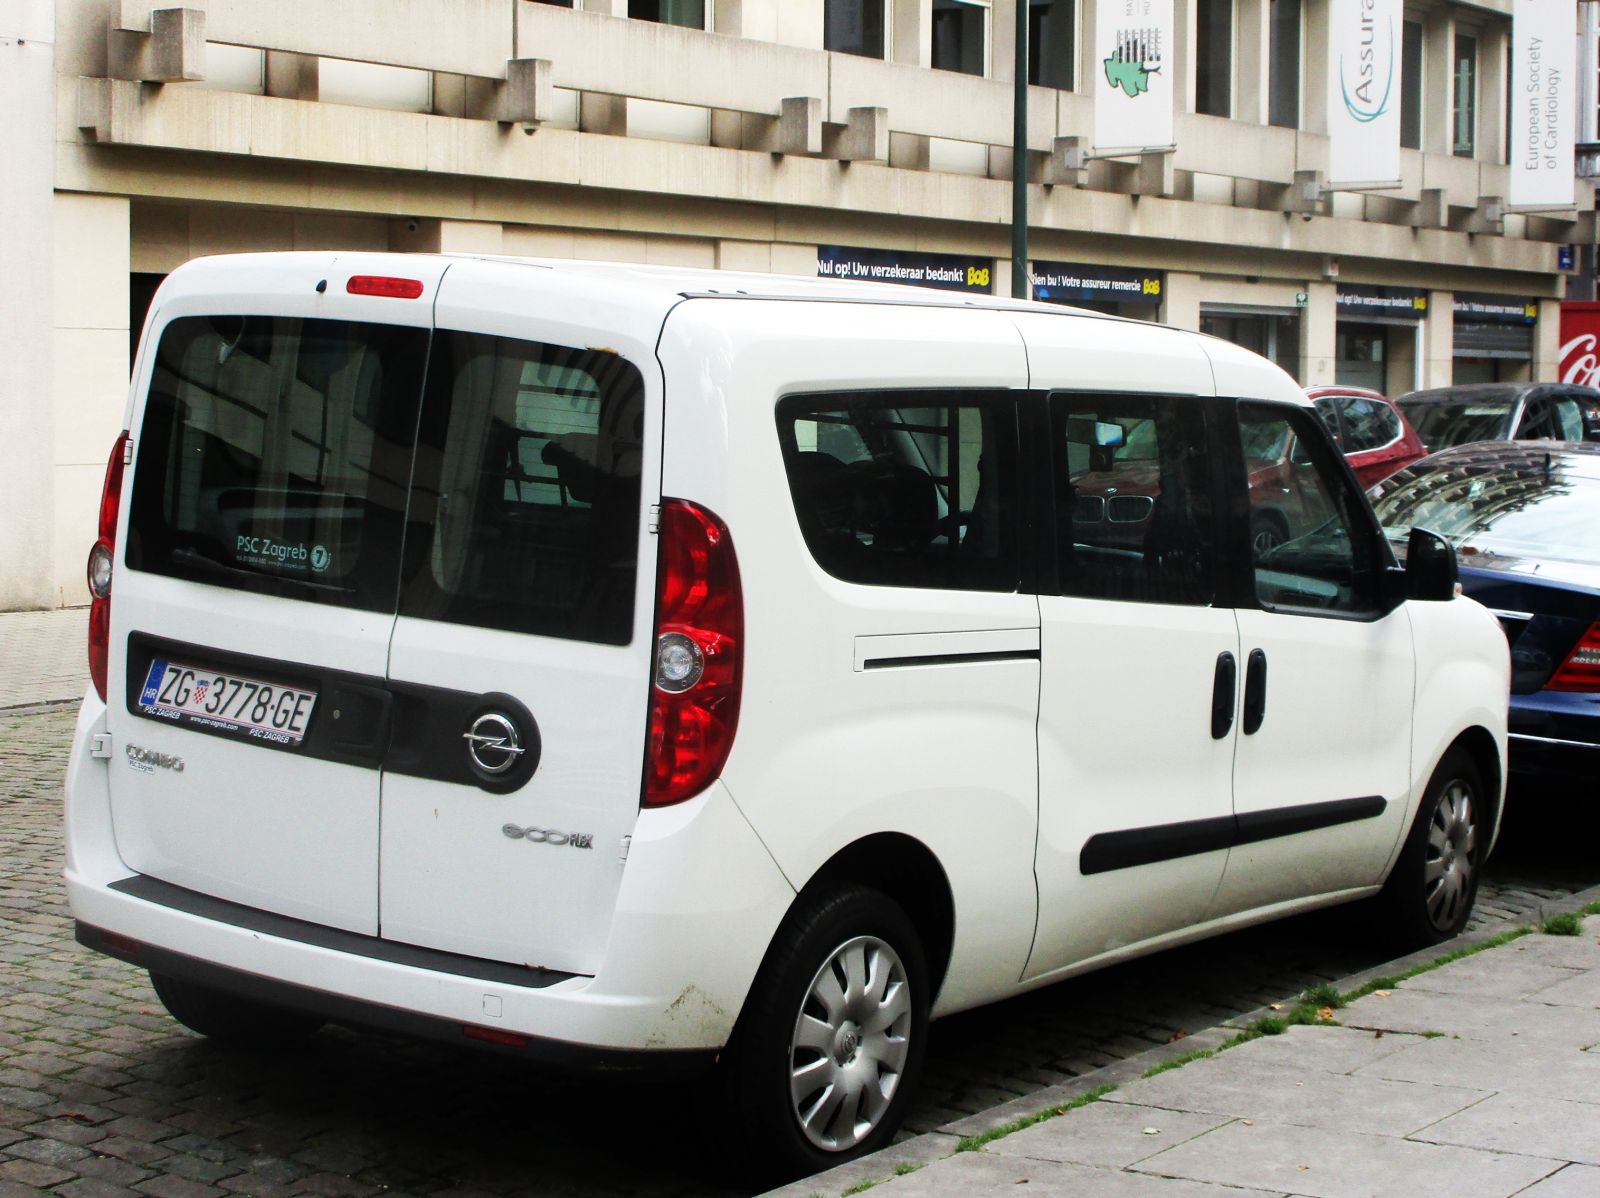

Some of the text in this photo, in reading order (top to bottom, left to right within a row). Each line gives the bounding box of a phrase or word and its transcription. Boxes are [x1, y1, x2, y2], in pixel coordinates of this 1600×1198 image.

[1525, 36, 1543, 170] European Society
[1544, 68, 1562, 169] of Cardiology
[817, 259, 833, 274] Nul
[835, 261, 851, 278] op!
[852, 262, 869, 276] Uw
[871, 264, 924, 280] verzekeraar
[926, 265, 964, 282] bedankt
[1047, 273, 1057, 286] bu
[1061, 275, 1081, 288] Votre
[1081, 278, 1111, 290] assureur
[1111, 280, 1141, 291] remercie
[236, 535, 308, 561] PSC Zagreb
[144, 687, 158, 699] HR
[158, 667, 195, 707] ZG
[143, 705, 181, 719] PSC ZAGREB
[249, 728, 290, 744] PSC ZAGREB
